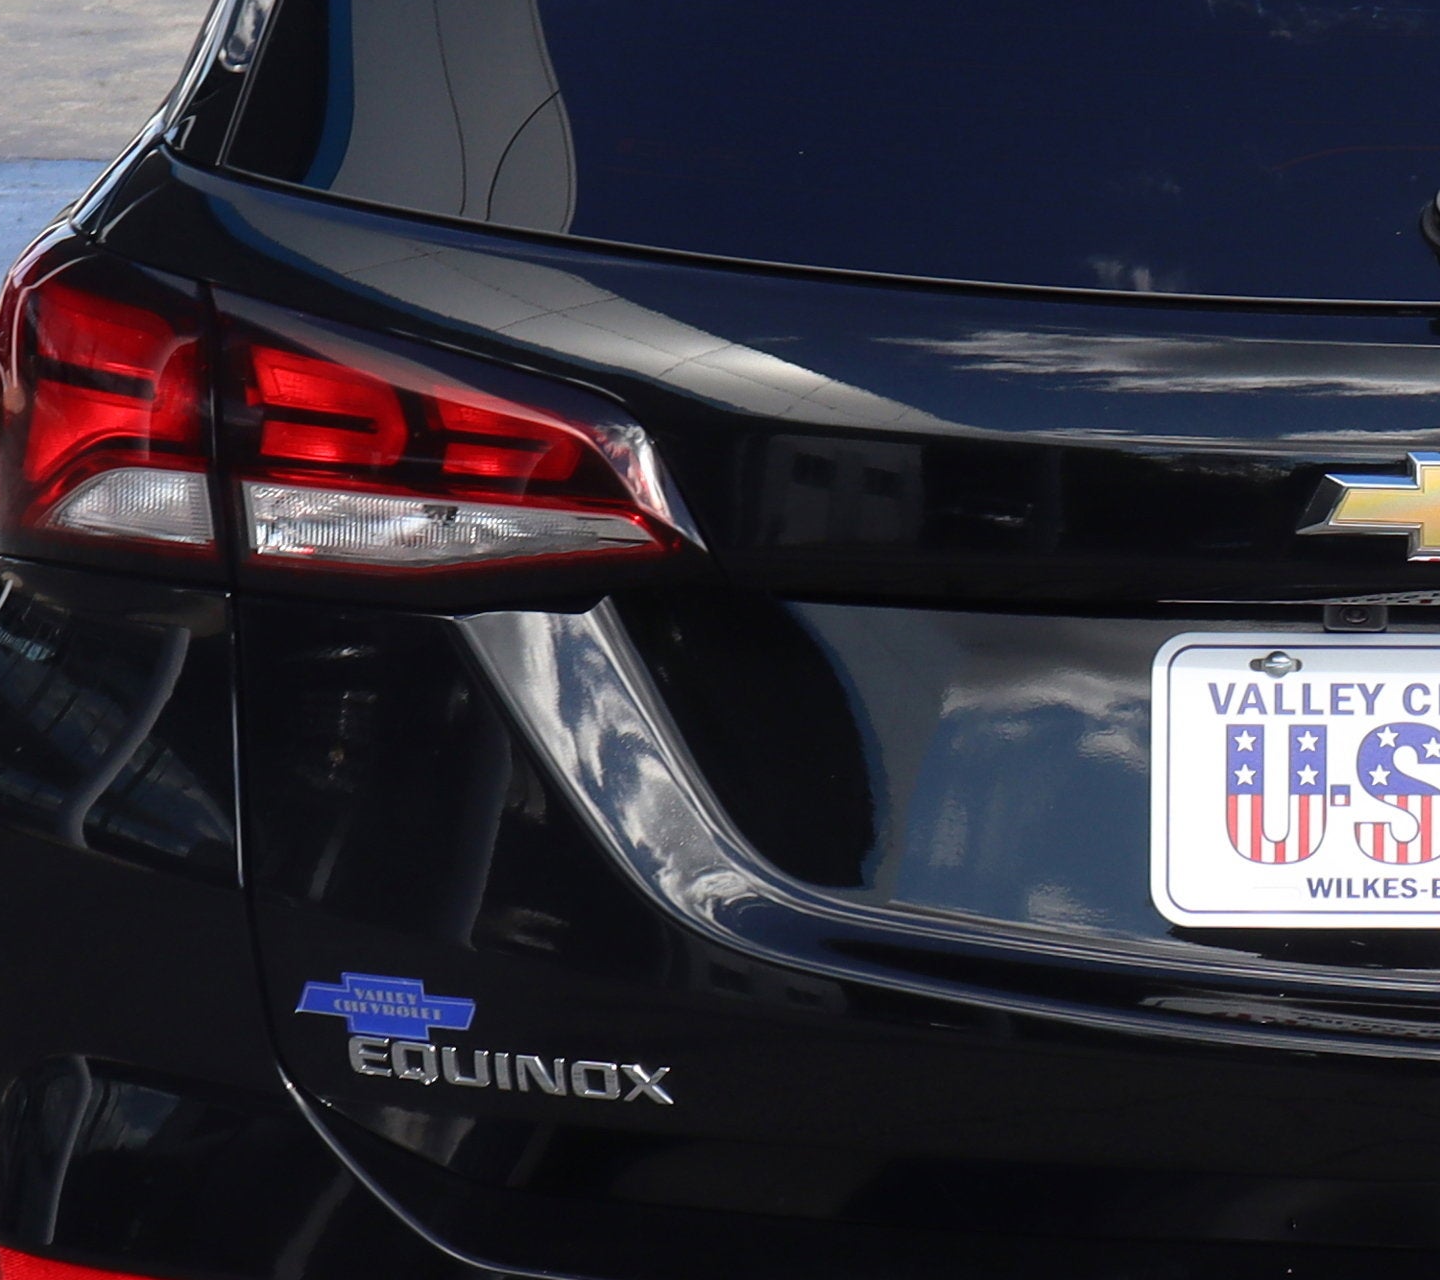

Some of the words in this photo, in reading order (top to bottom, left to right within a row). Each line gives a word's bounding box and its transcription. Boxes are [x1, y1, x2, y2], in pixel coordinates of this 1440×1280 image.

[1207, 682, 1385, 717] VALLEY
[333, 998, 443, 1021] CHEVROLET
[353, 987, 418, 1006] VALLEY
[347, 1034, 675, 1106] EQUINOX
